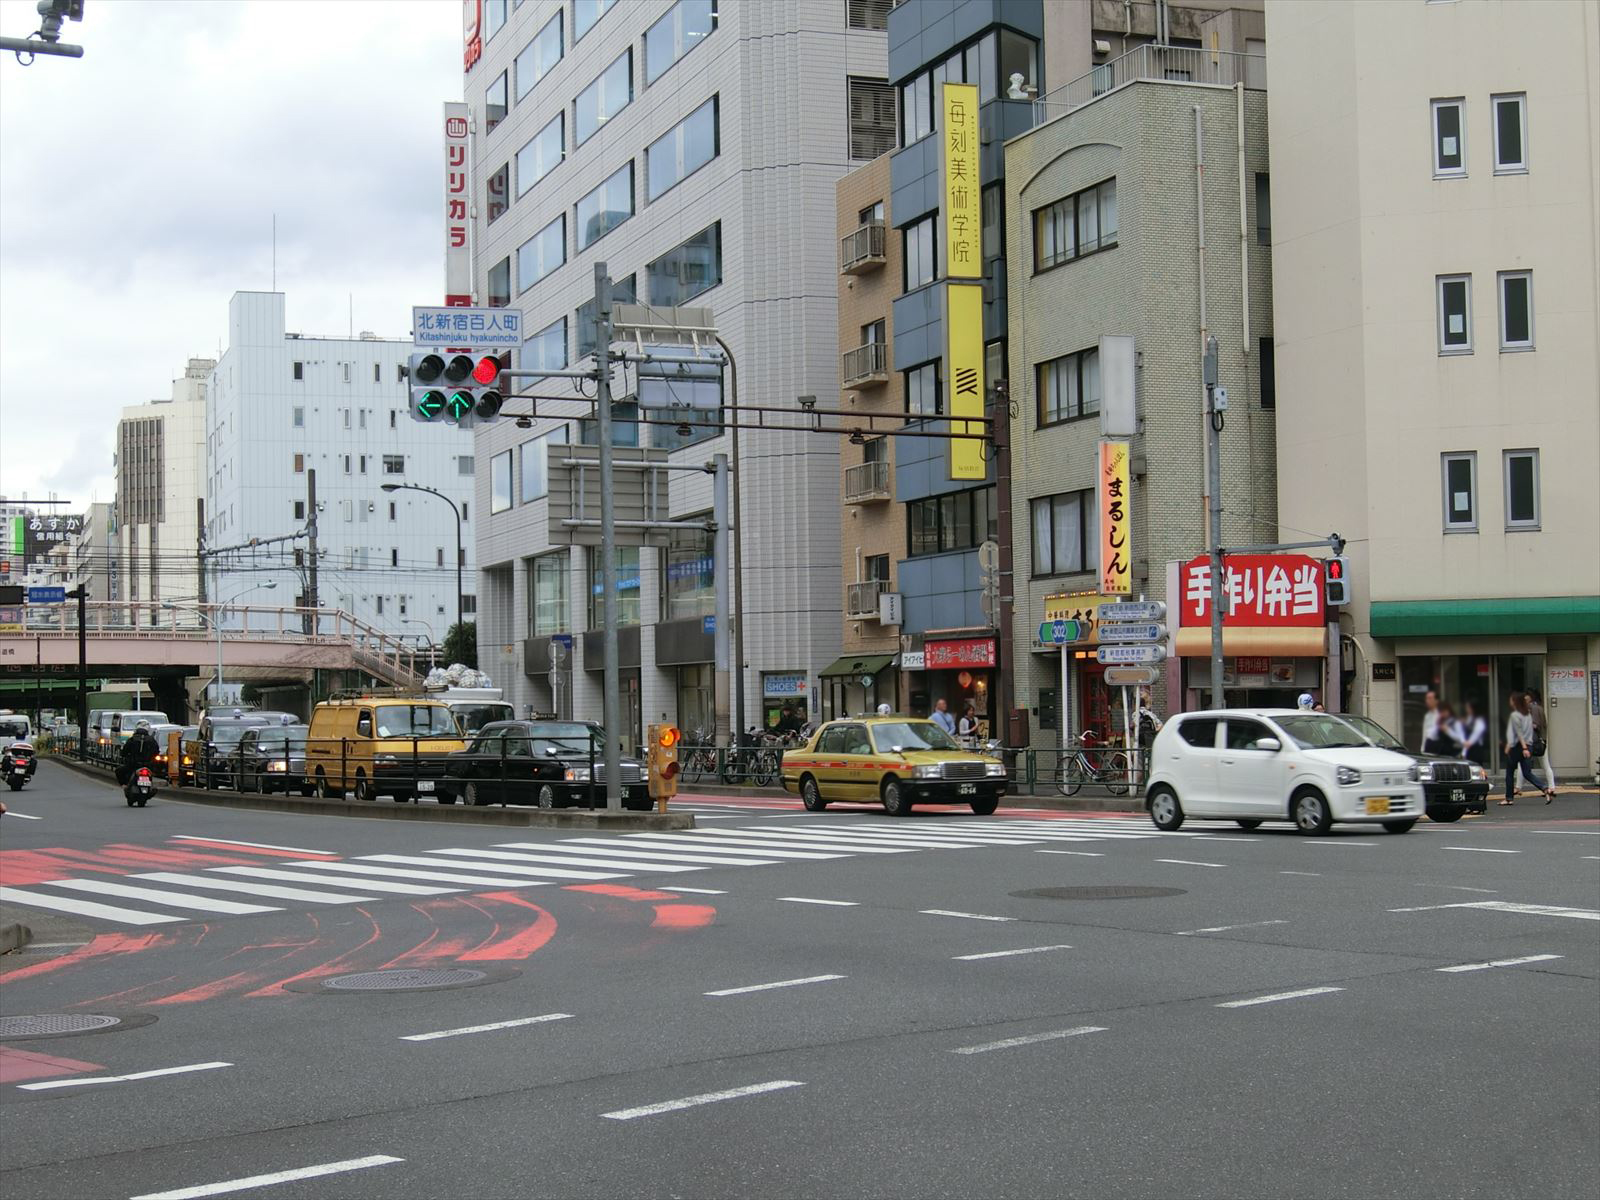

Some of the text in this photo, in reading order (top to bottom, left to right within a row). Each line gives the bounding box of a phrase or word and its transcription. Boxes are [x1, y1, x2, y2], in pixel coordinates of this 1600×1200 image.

[449, 146, 466, 248] リリカラ
[418, 312, 518, 332] 北新宿百人町
[419, 332, 518, 344] Kitashinjuku hyakunincho
[29, 517, 80, 531] あすか
[1108, 477, 1128, 575] まるしん
[1186, 564, 1319, 617] 手作り弁当
[1053, 625, 1066, 638] 302
[767, 682, 796, 692] SHOES
